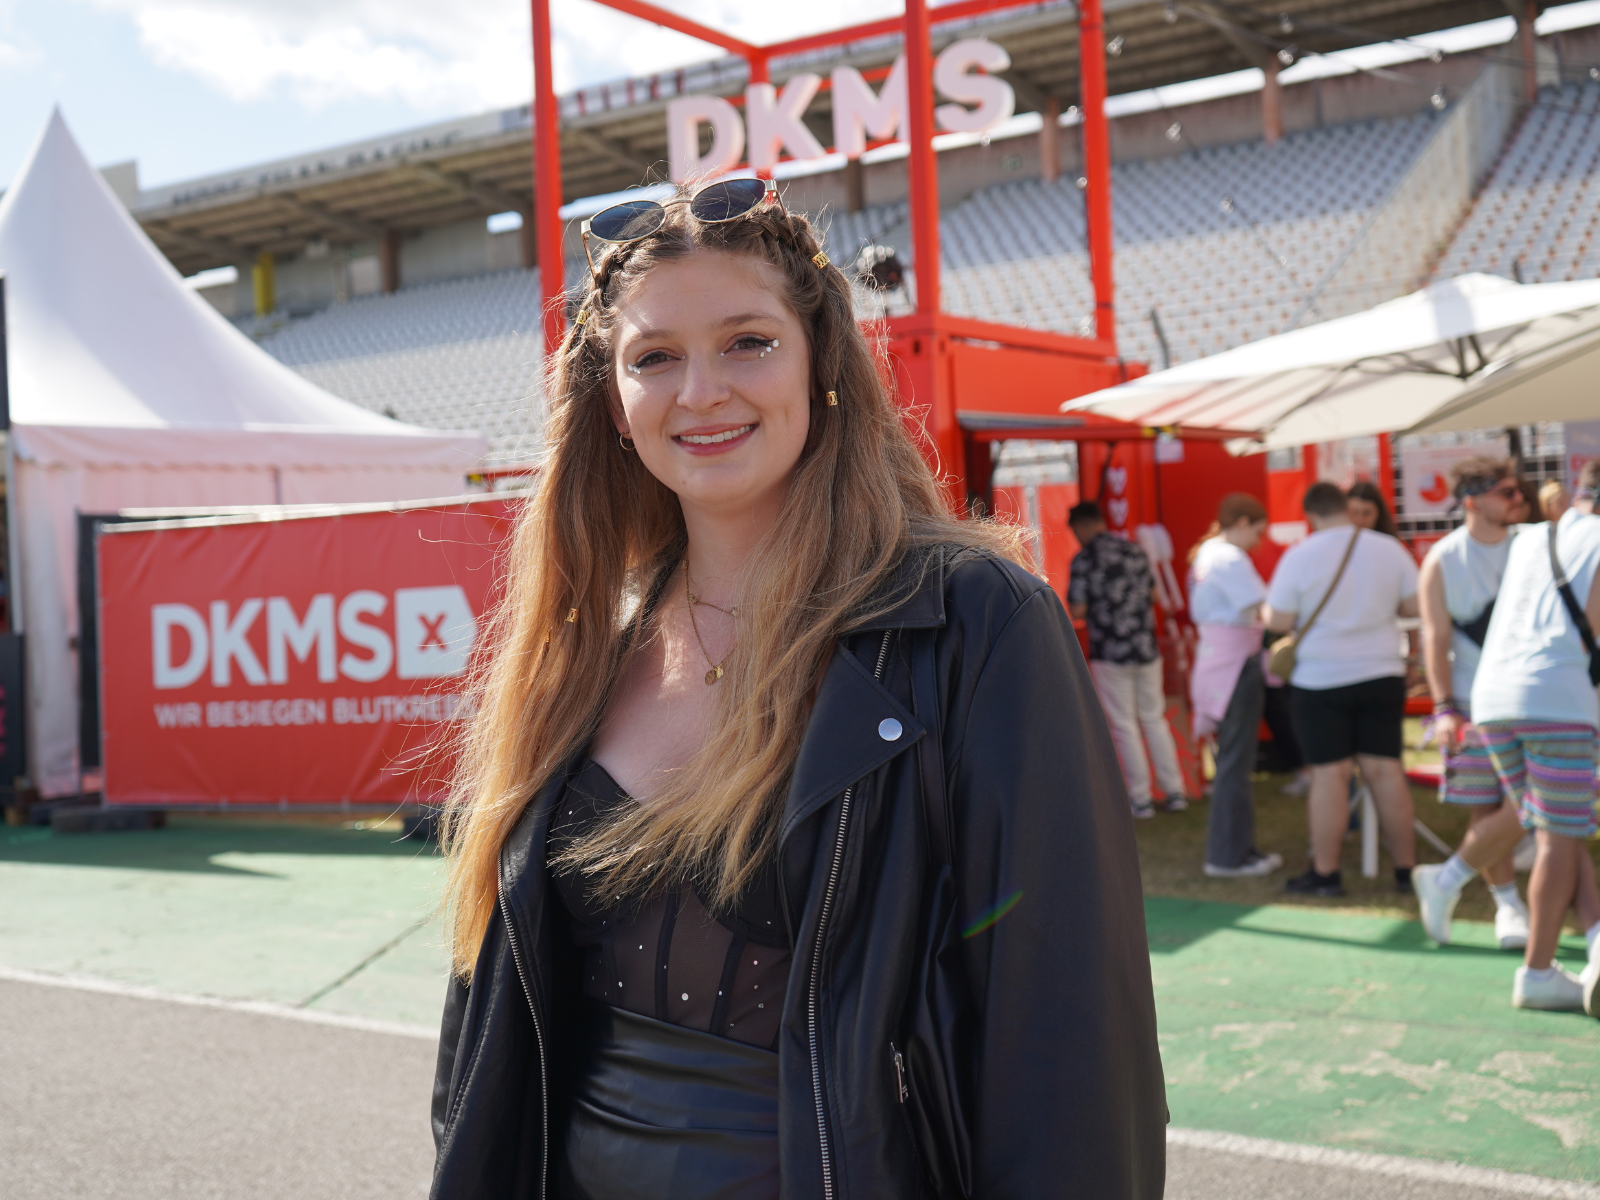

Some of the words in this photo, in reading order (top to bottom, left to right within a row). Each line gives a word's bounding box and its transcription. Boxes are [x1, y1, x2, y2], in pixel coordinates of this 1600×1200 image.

[667, 38, 1015, 184] DKMS
[151, 589, 393, 690] DKMS
[154, 703, 202, 728] WIR
[206, 698, 327, 727] BESIEGEN
